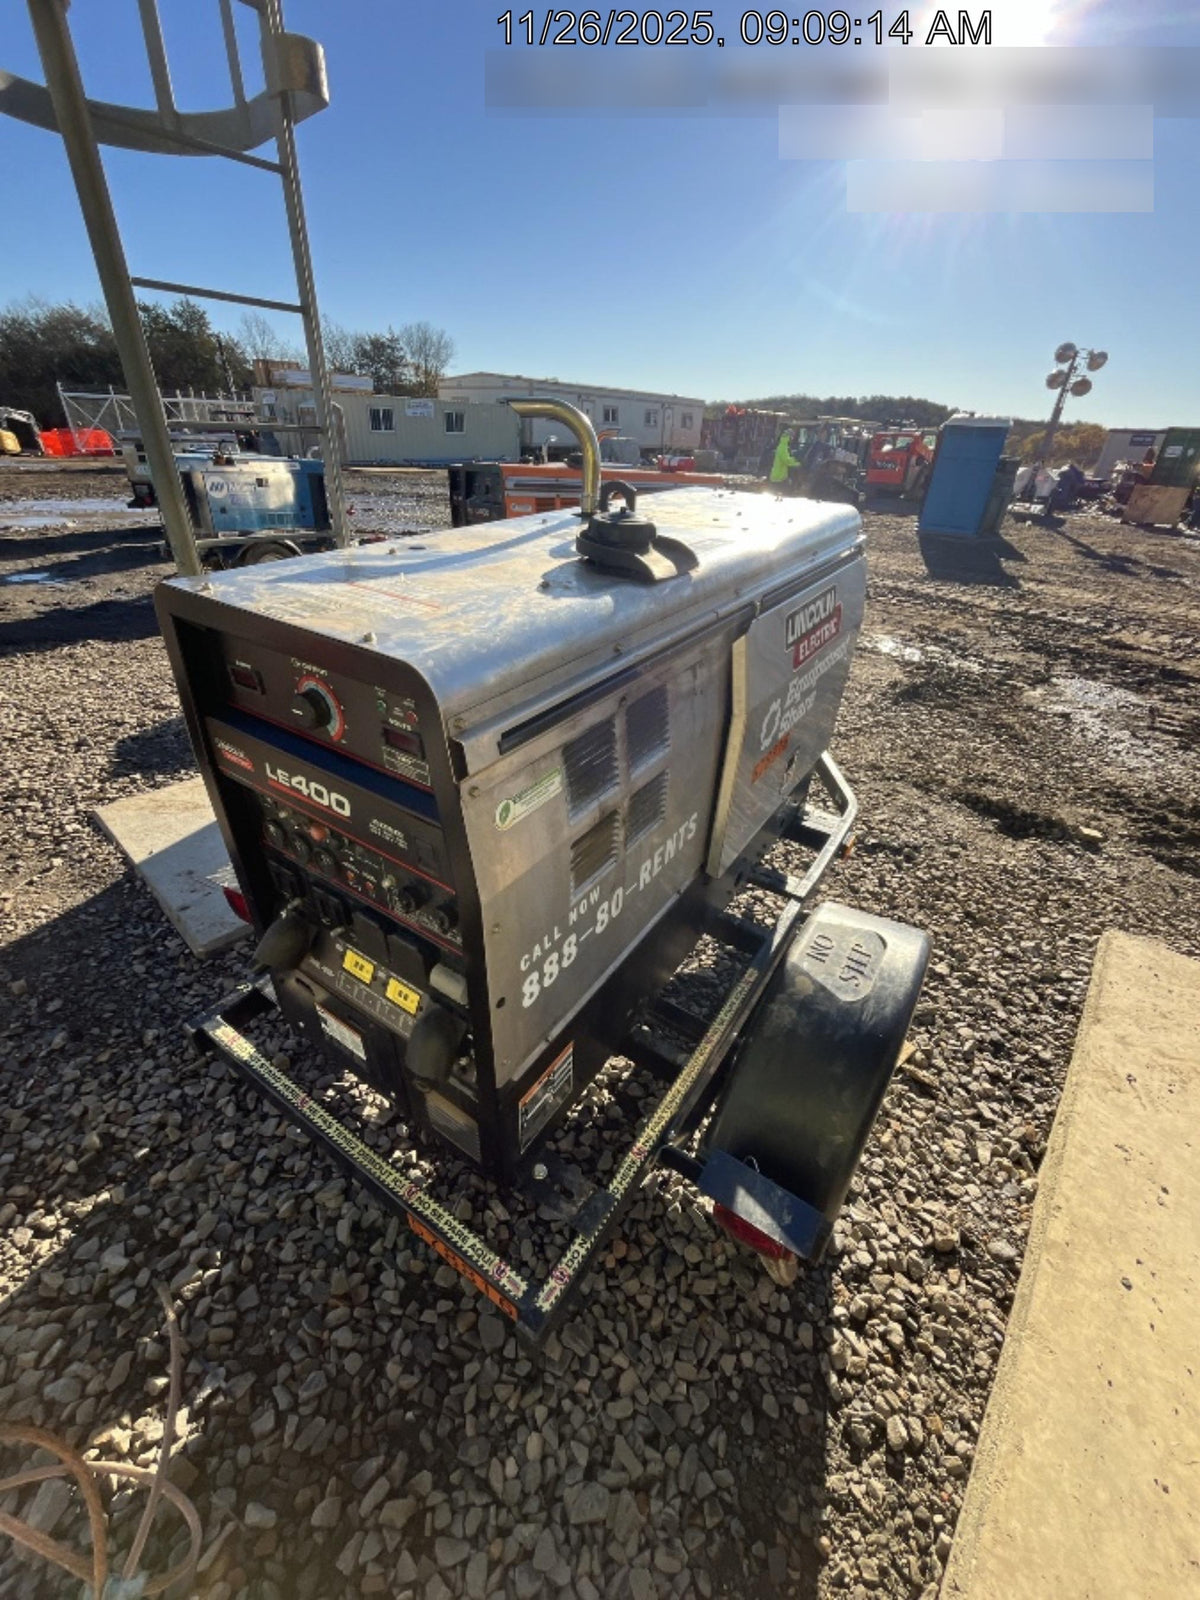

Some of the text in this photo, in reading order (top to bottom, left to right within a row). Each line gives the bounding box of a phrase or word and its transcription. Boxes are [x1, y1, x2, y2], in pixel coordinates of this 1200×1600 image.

[788, 589, 836, 645] LINCOLN
[799, 617, 839, 661] ELECTRIC
[265, 762, 351, 817] LE400
[520, 887, 601, 972] CALL NOW
[522, 813, 698, 1009] 888-80-RENTS
[806, 934, 835, 964] NO
[839, 943, 872, 987] STEP
[331, 1125, 359, 1152] TENEZ
[355, 1146, 393, 1181] DEBOUT
[414, 1192, 432, 1214] NO
[429, 1204, 445, 1225] SE
[442, 1216, 470, 1247] PARE
